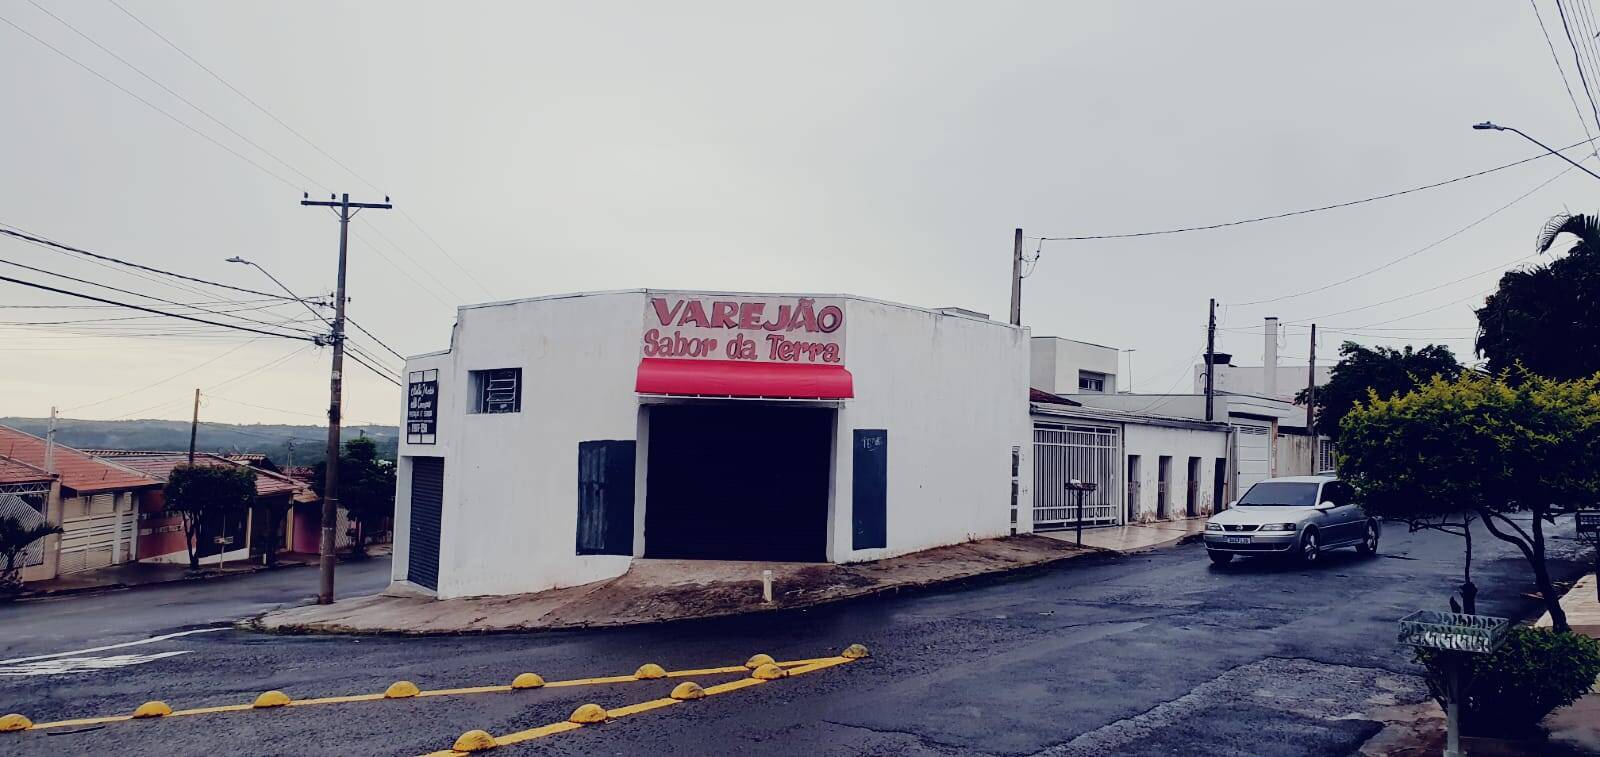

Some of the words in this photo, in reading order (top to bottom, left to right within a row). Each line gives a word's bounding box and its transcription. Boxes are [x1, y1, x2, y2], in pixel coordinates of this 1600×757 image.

[651, 297, 843, 333] VAREJÃO
[643, 328, 718, 357] Sabor
[726, 333, 758, 360] da
[765, 334, 840, 363] Terra
